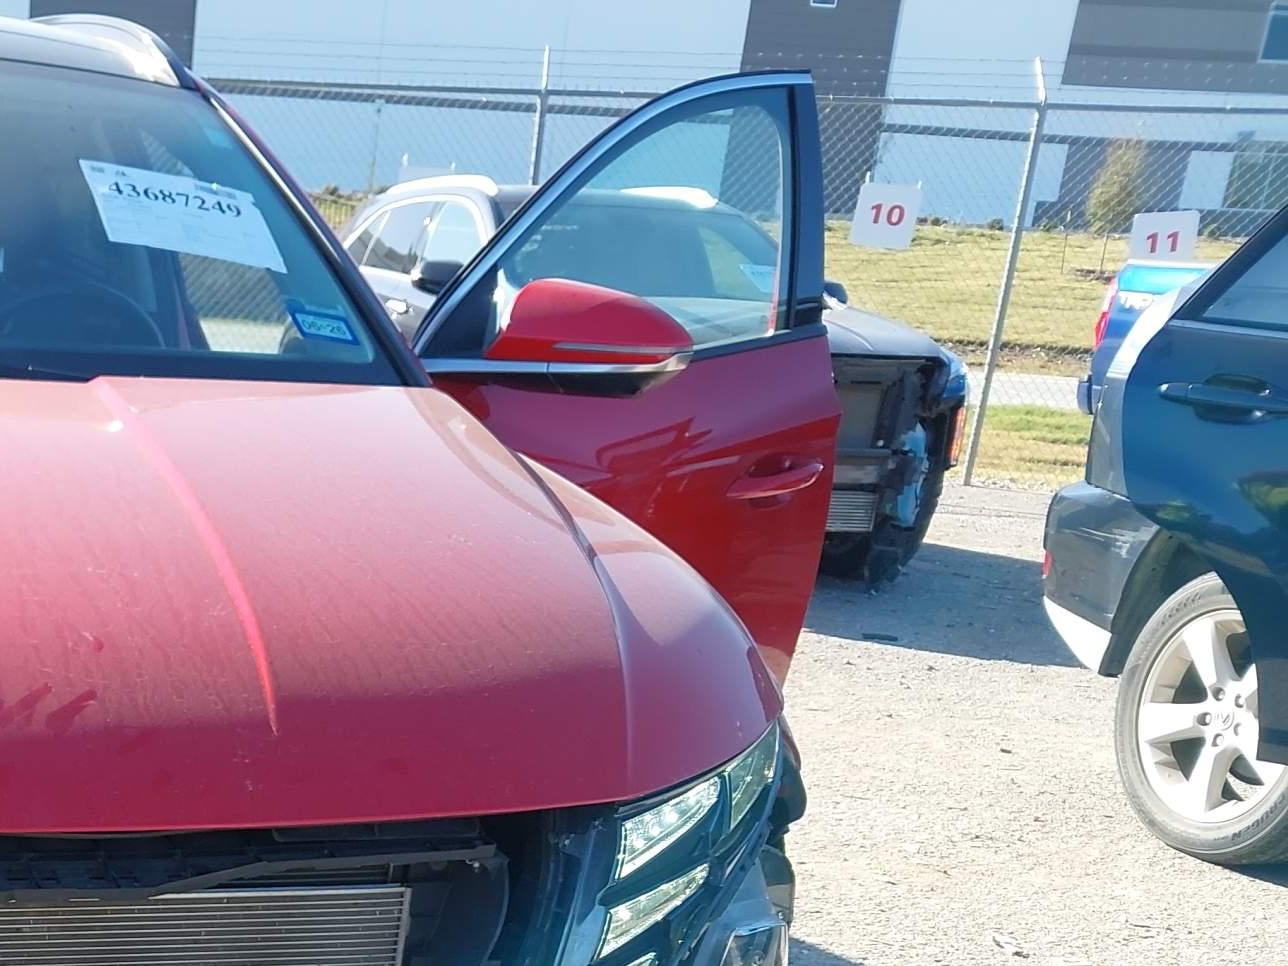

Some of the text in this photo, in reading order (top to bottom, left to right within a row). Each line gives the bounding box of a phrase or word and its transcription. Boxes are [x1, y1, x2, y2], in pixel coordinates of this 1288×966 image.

[108, 181, 242, 218] 43687249
[871, 203, 905, 226] 10
[1146, 230, 1180, 253] 11
